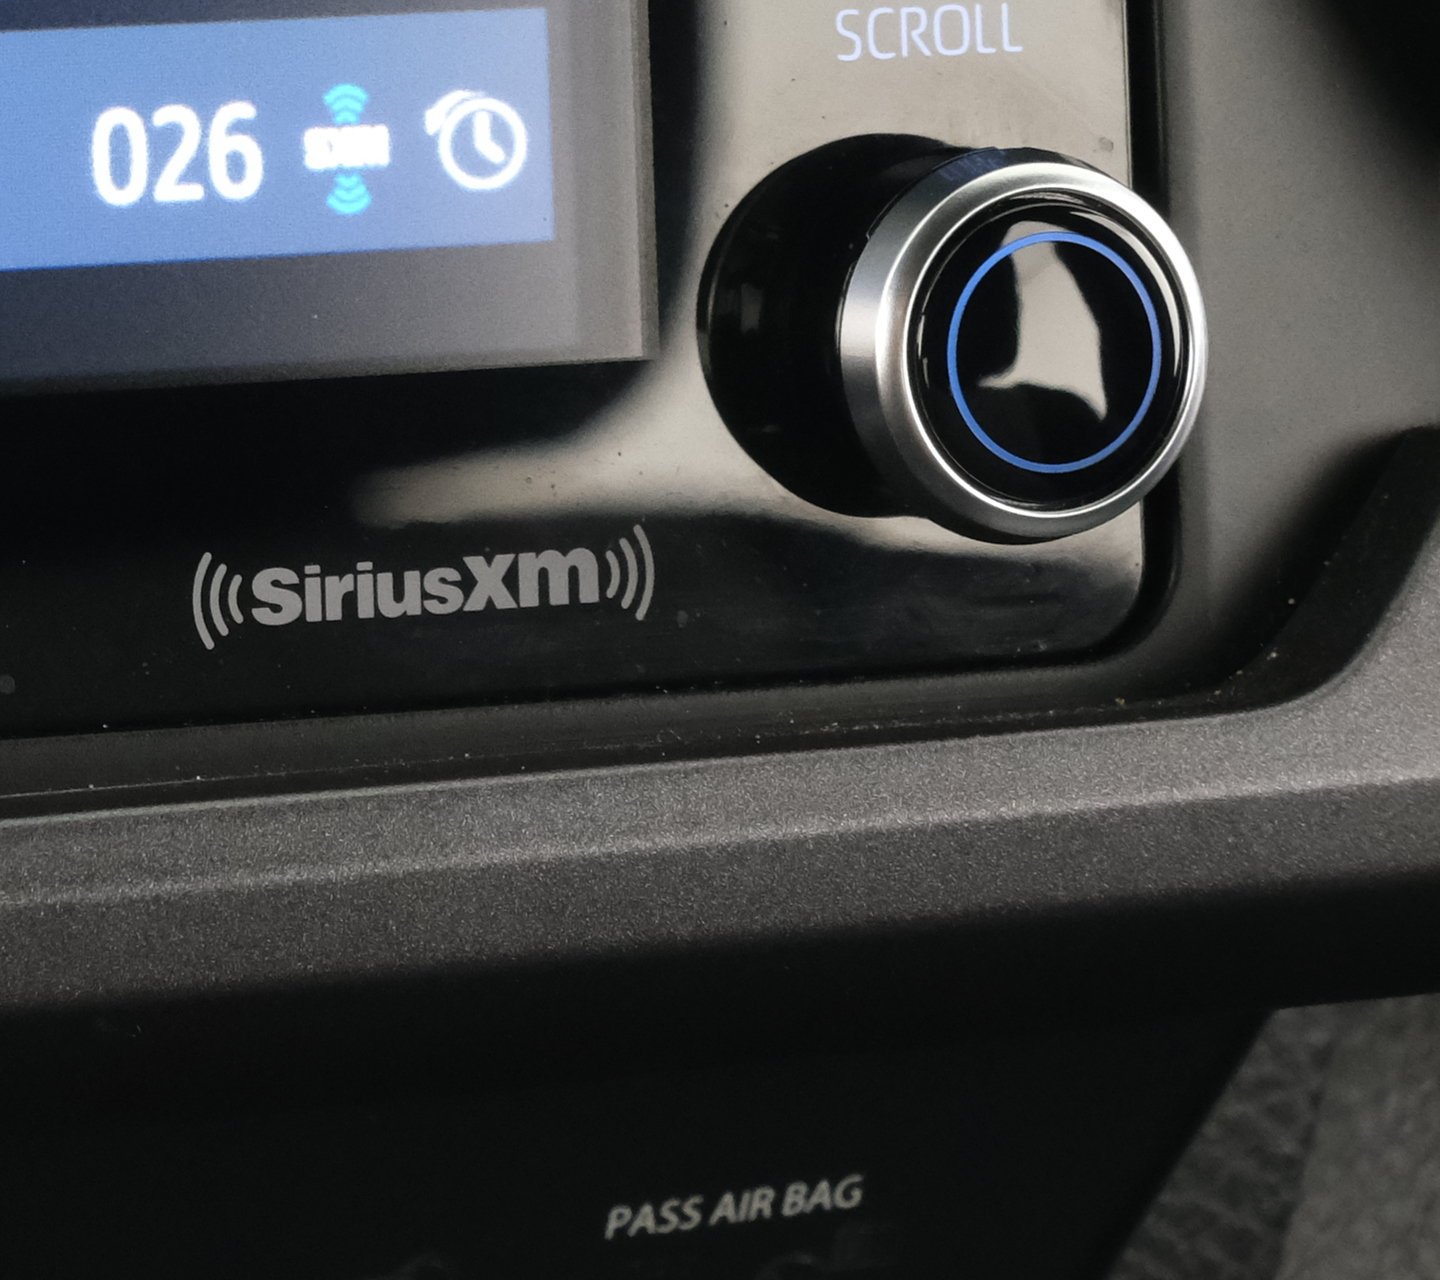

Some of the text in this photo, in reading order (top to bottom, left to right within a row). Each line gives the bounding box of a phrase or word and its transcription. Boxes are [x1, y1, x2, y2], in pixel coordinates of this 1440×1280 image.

[835, 2, 1024, 62] SCROLL
[90, 99, 266, 208] 026
[604, 1173, 865, 1241] PASS AIR BAG
